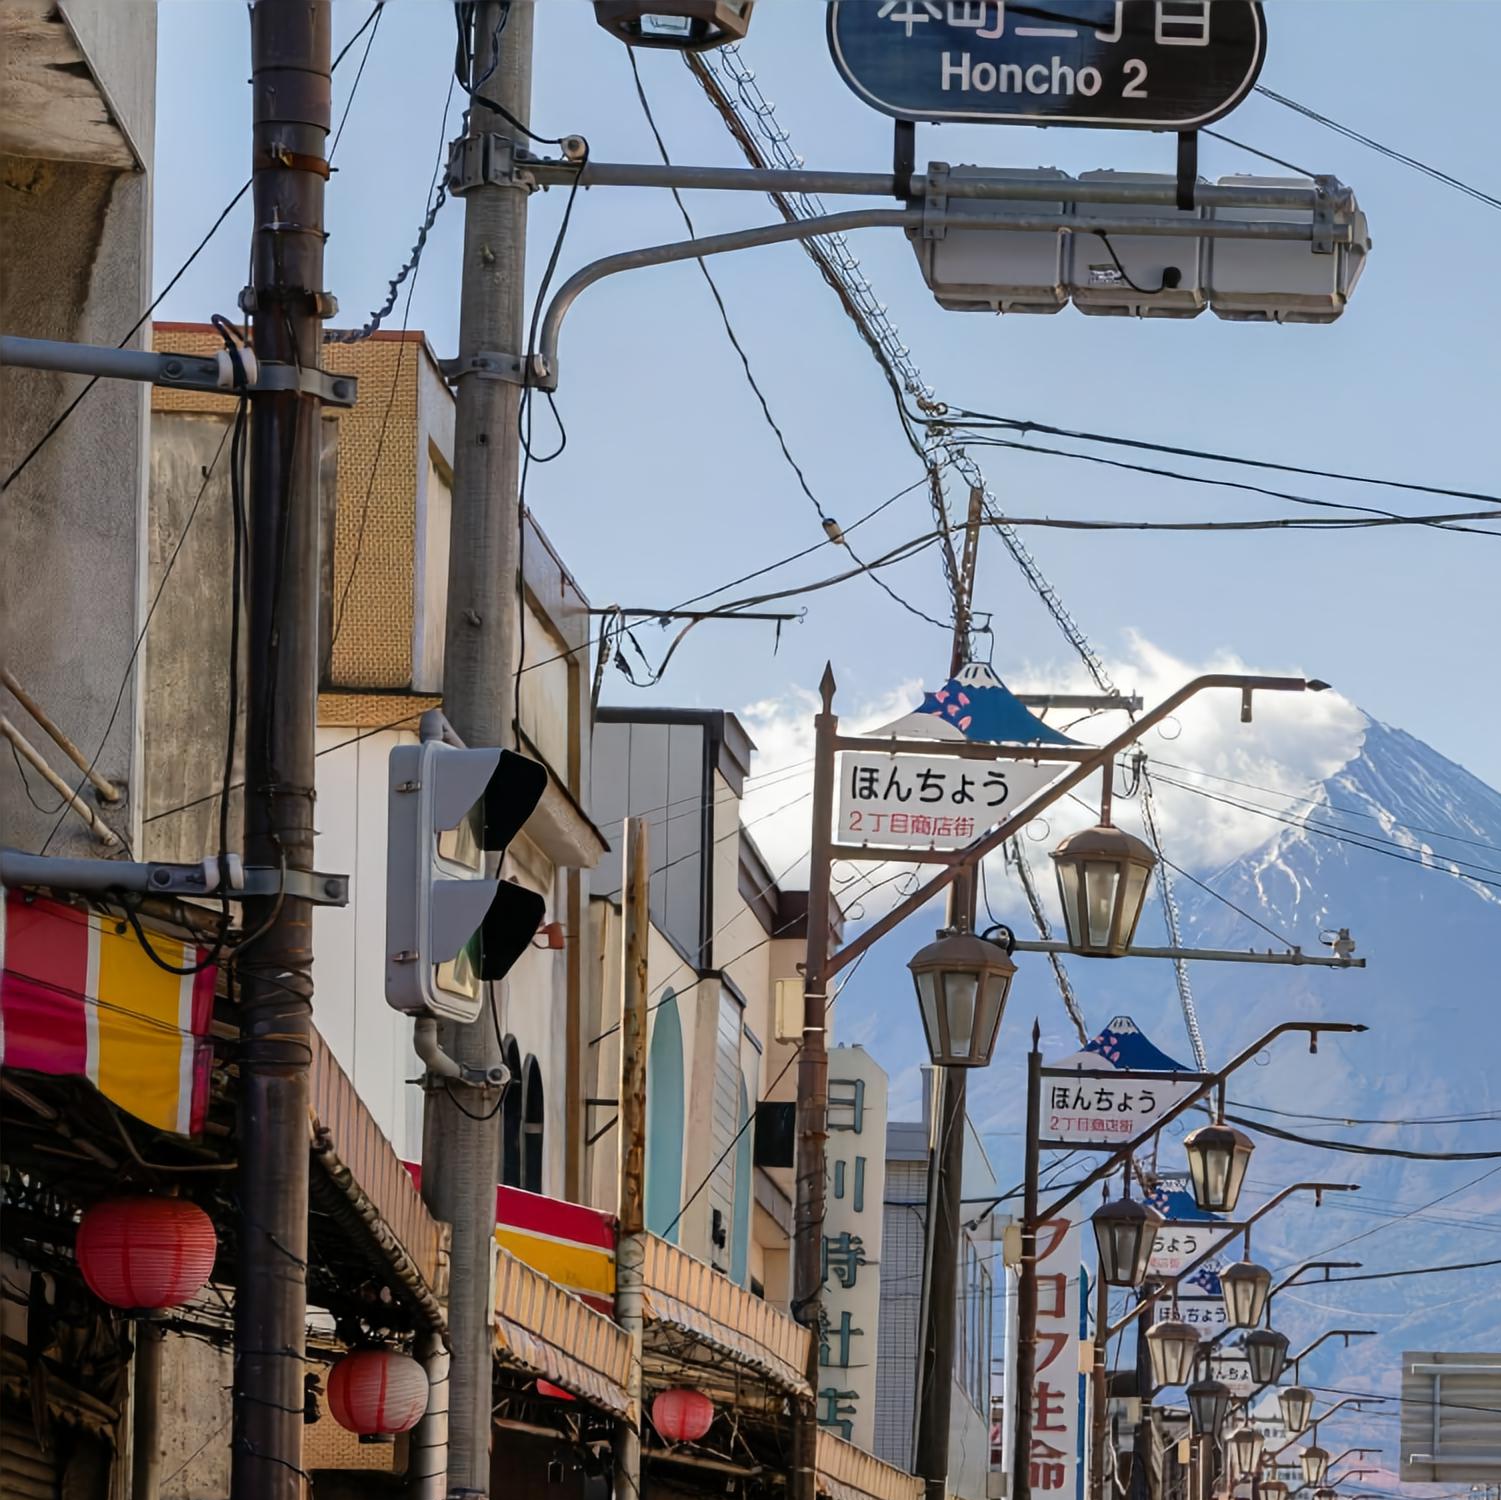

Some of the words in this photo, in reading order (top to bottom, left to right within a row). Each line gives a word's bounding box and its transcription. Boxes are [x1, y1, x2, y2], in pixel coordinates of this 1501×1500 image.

[941, 51, 1101, 97] Honcho
[1122, 58, 1148, 98] 2
[852, 766, 1009, 807] ほんちょう
[849, 810, 975, 838] 2丁目商店街
[1051, 1086, 1156, 1114] ほんちょう
